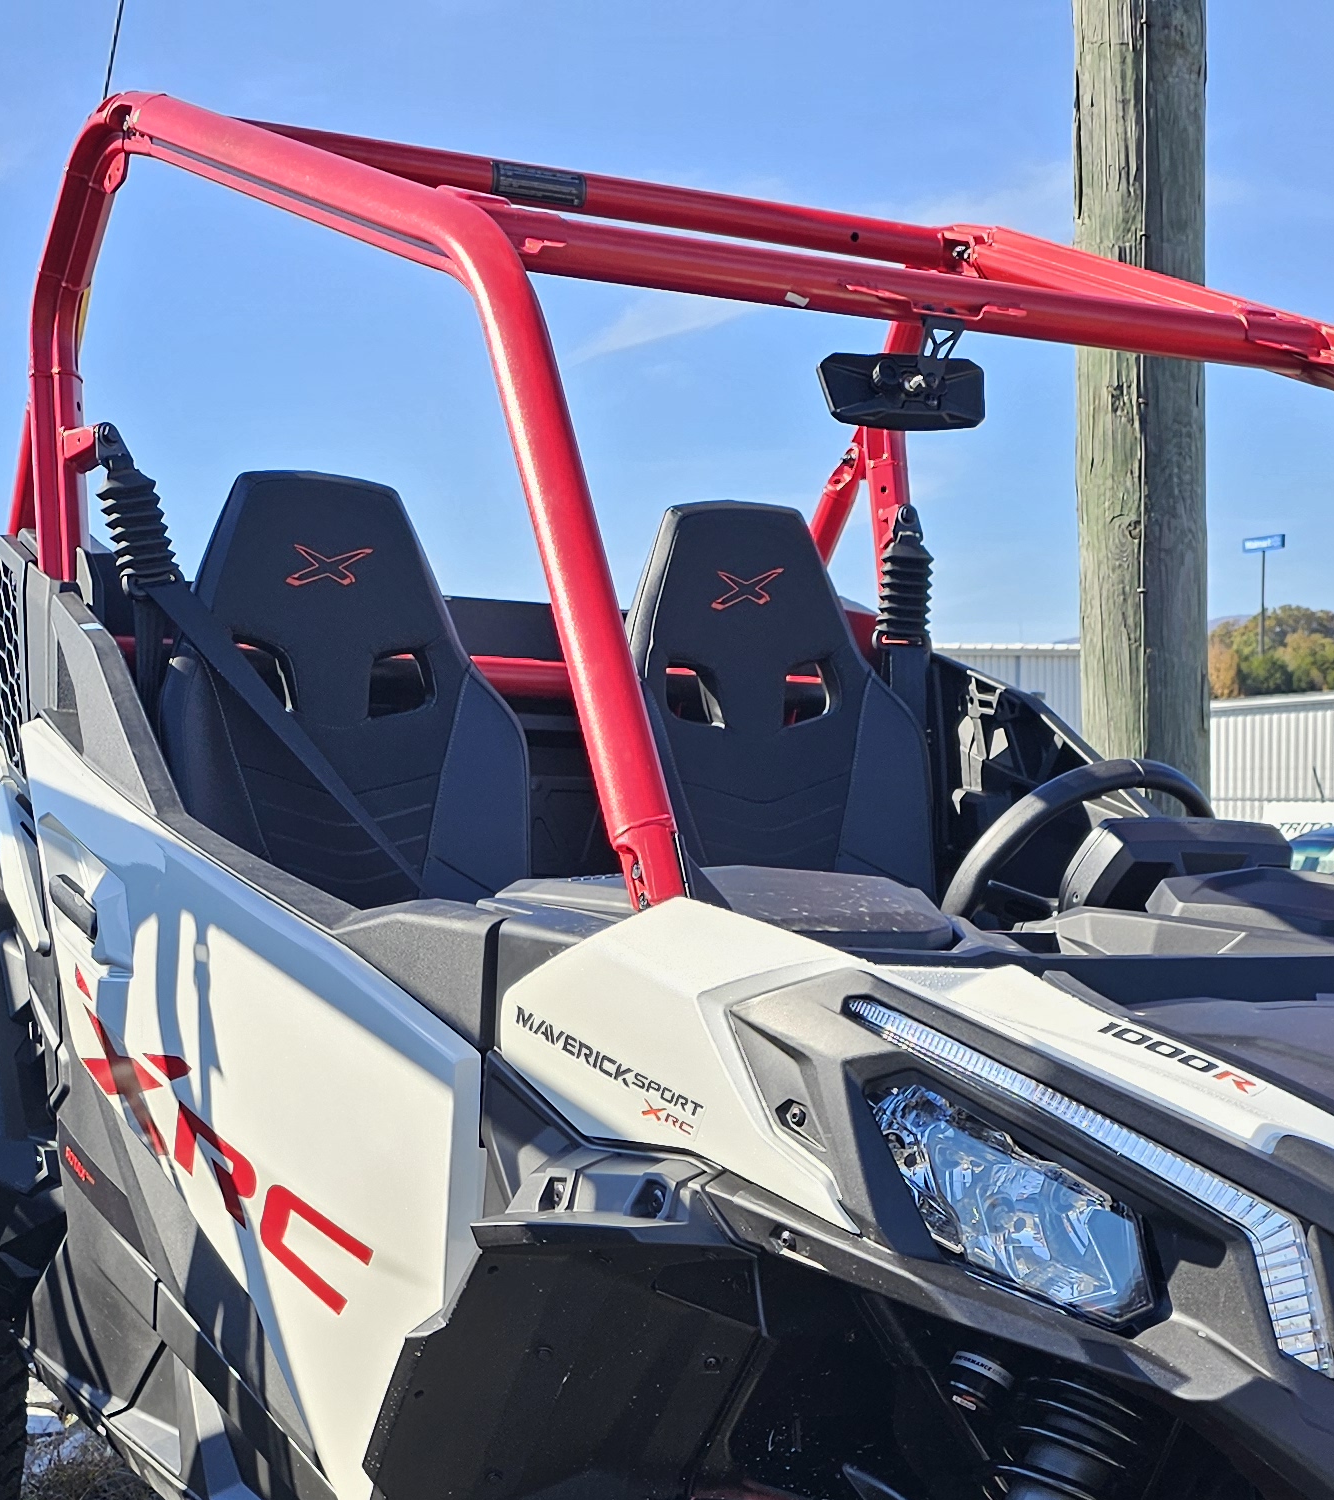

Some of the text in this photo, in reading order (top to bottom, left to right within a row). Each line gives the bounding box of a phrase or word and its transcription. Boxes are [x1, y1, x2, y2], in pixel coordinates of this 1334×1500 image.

[515, 1004, 704, 1118] MAVERICK SPORT
[1097, 1021, 1257, 1095] 1000R
[642, 1098, 695, 1136] XRC
